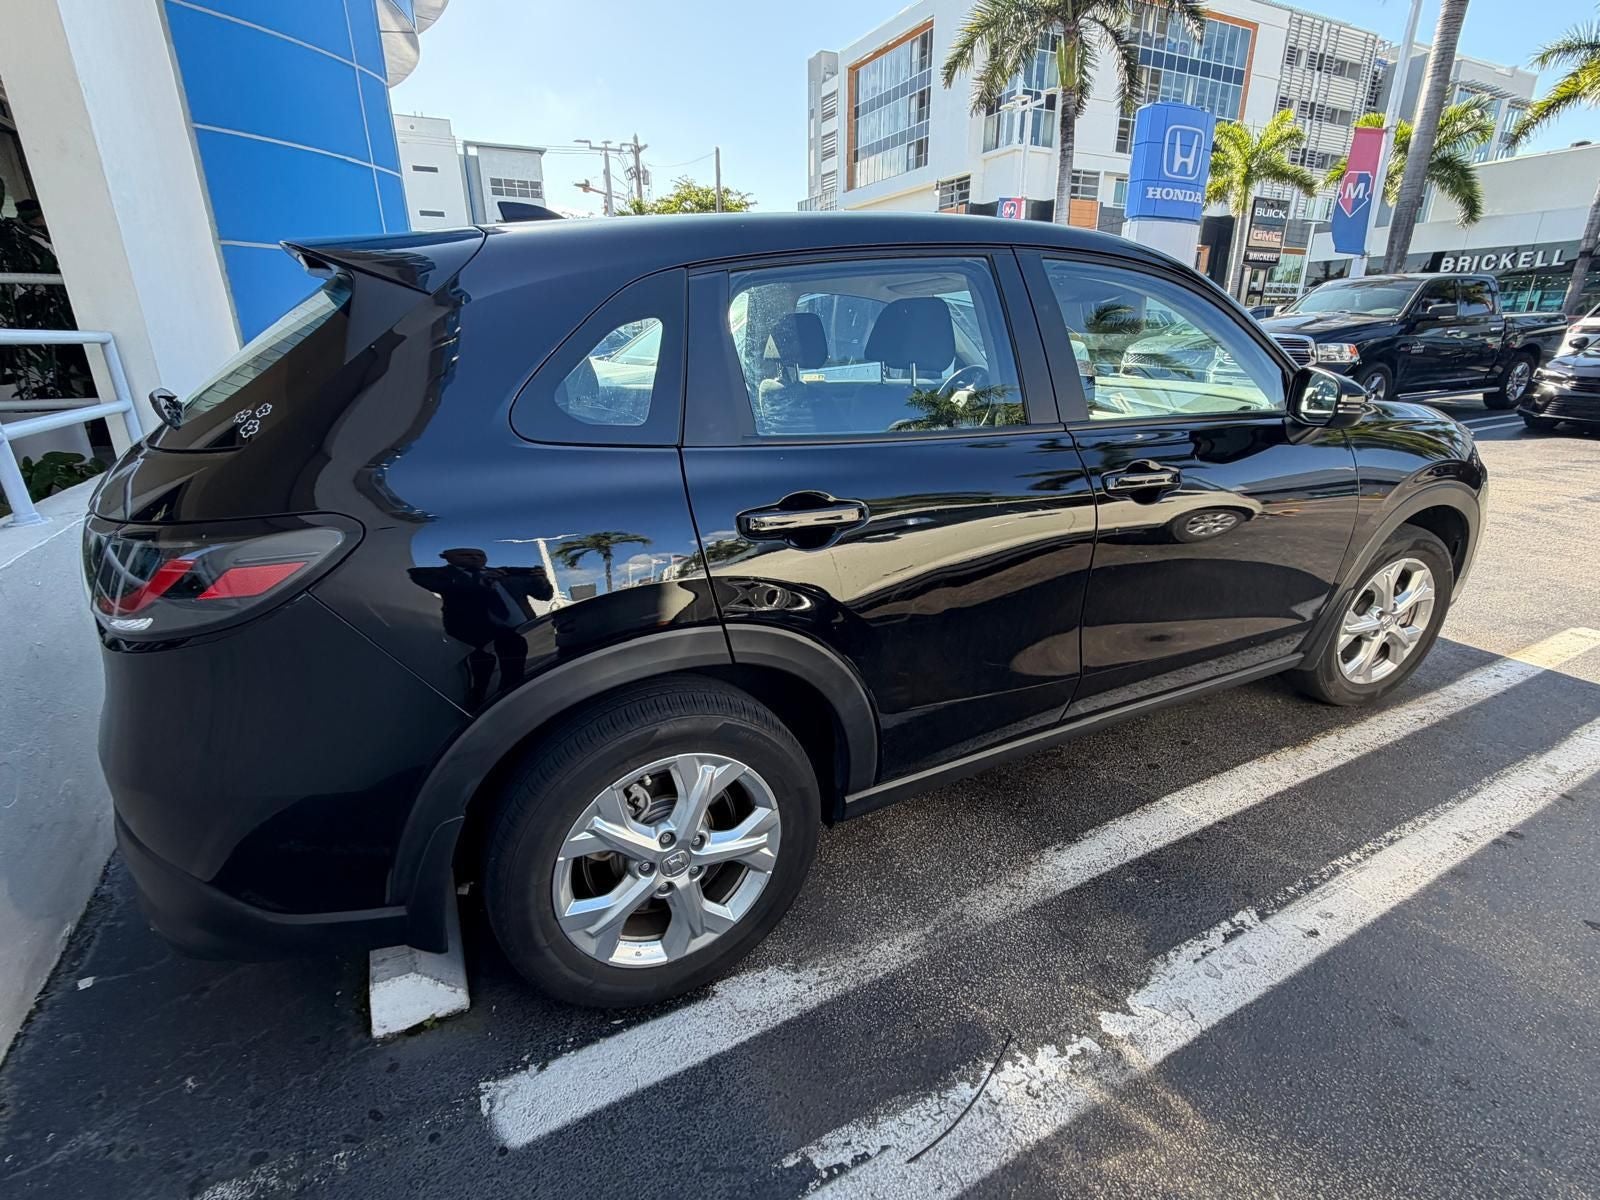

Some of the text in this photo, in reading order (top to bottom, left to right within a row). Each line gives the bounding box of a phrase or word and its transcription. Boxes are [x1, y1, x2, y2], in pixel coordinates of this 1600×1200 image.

[1145, 186, 1203, 204] HONDA
[1344, 182, 1365, 199] M
[1255, 207, 1287, 219] BUICK
[1252, 230, 1282, 242] GMC
[1248, 252, 1277, 262] BRICKELL
[1439, 249, 1566, 273] BRICKELL
